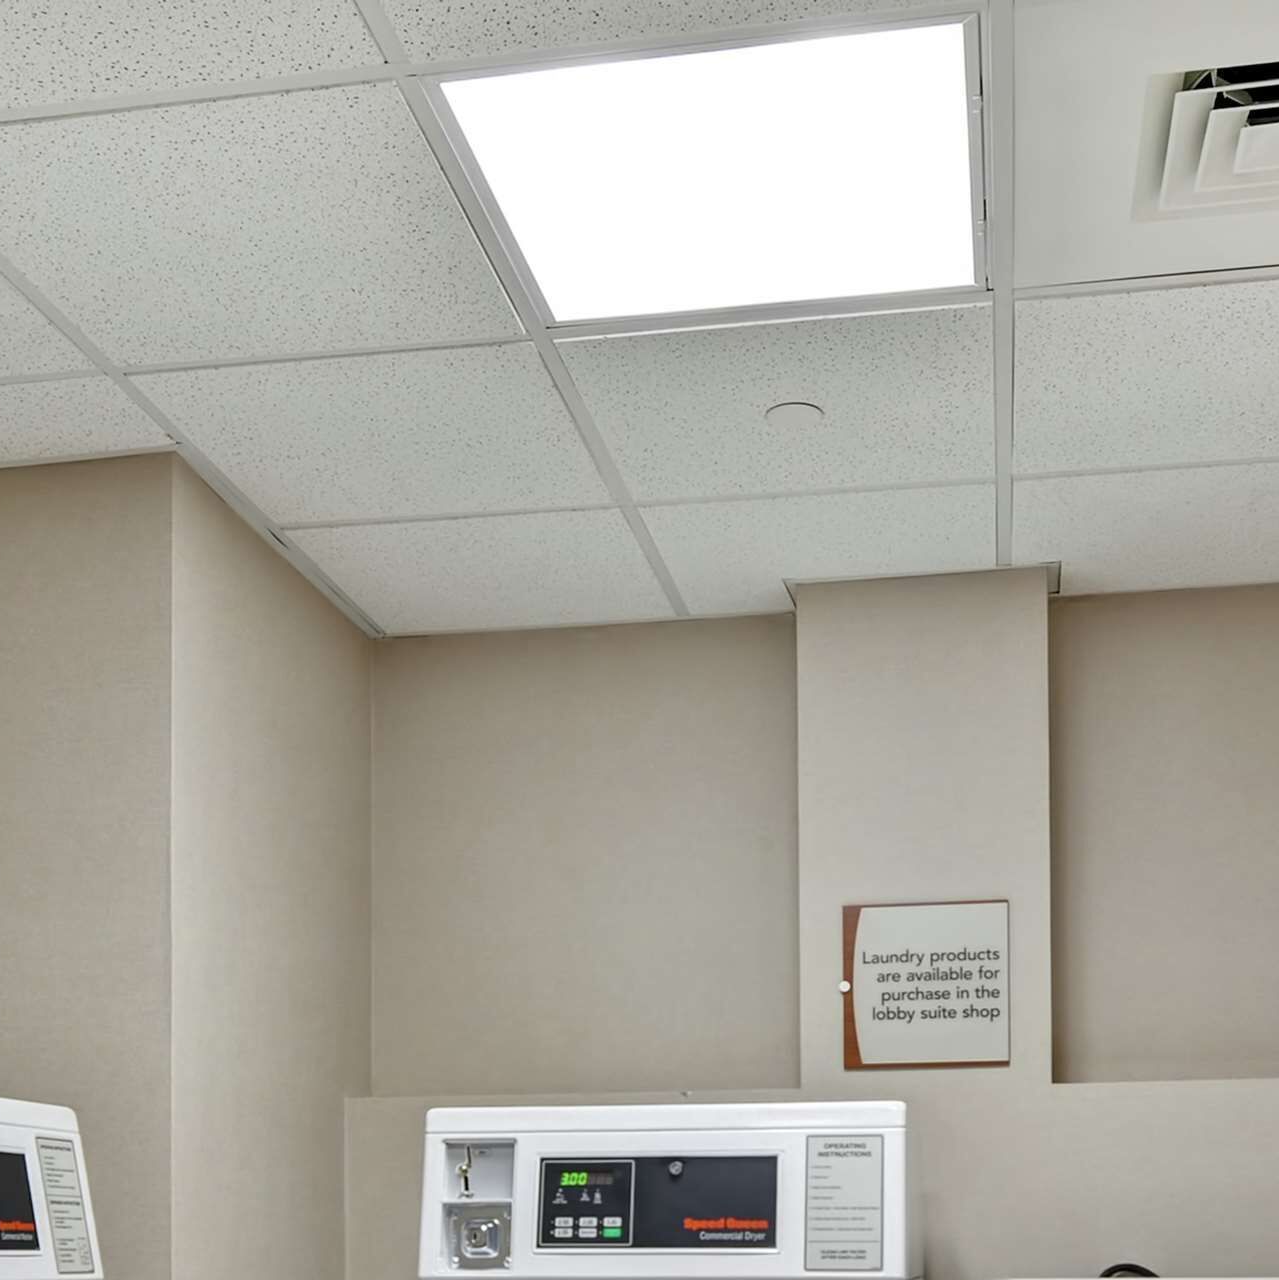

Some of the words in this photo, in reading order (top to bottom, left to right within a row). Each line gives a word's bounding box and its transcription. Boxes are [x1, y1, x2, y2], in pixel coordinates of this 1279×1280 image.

[862, 949, 925, 967] Laundry
[930, 947, 1000, 967] products
[877, 971, 901, 984] are
[906, 966, 973, 983] available
[978, 965, 1000, 980] for
[881, 986, 951, 1006] purchase
[956, 985, 970, 999] in
[975, 985, 1000, 999] the
[872, 1006, 915, 1024] lobby
[920, 1005, 957, 1020] suite
[962, 1003, 1001, 1022] shop
[817, 1150, 873, 1158] INSTRUCTIONS
[823, 1142, 867, 1150] OPERATING
[699, 1230, 743, 1241] Commercial
[744, 1230, 767, 1242] Dryer
